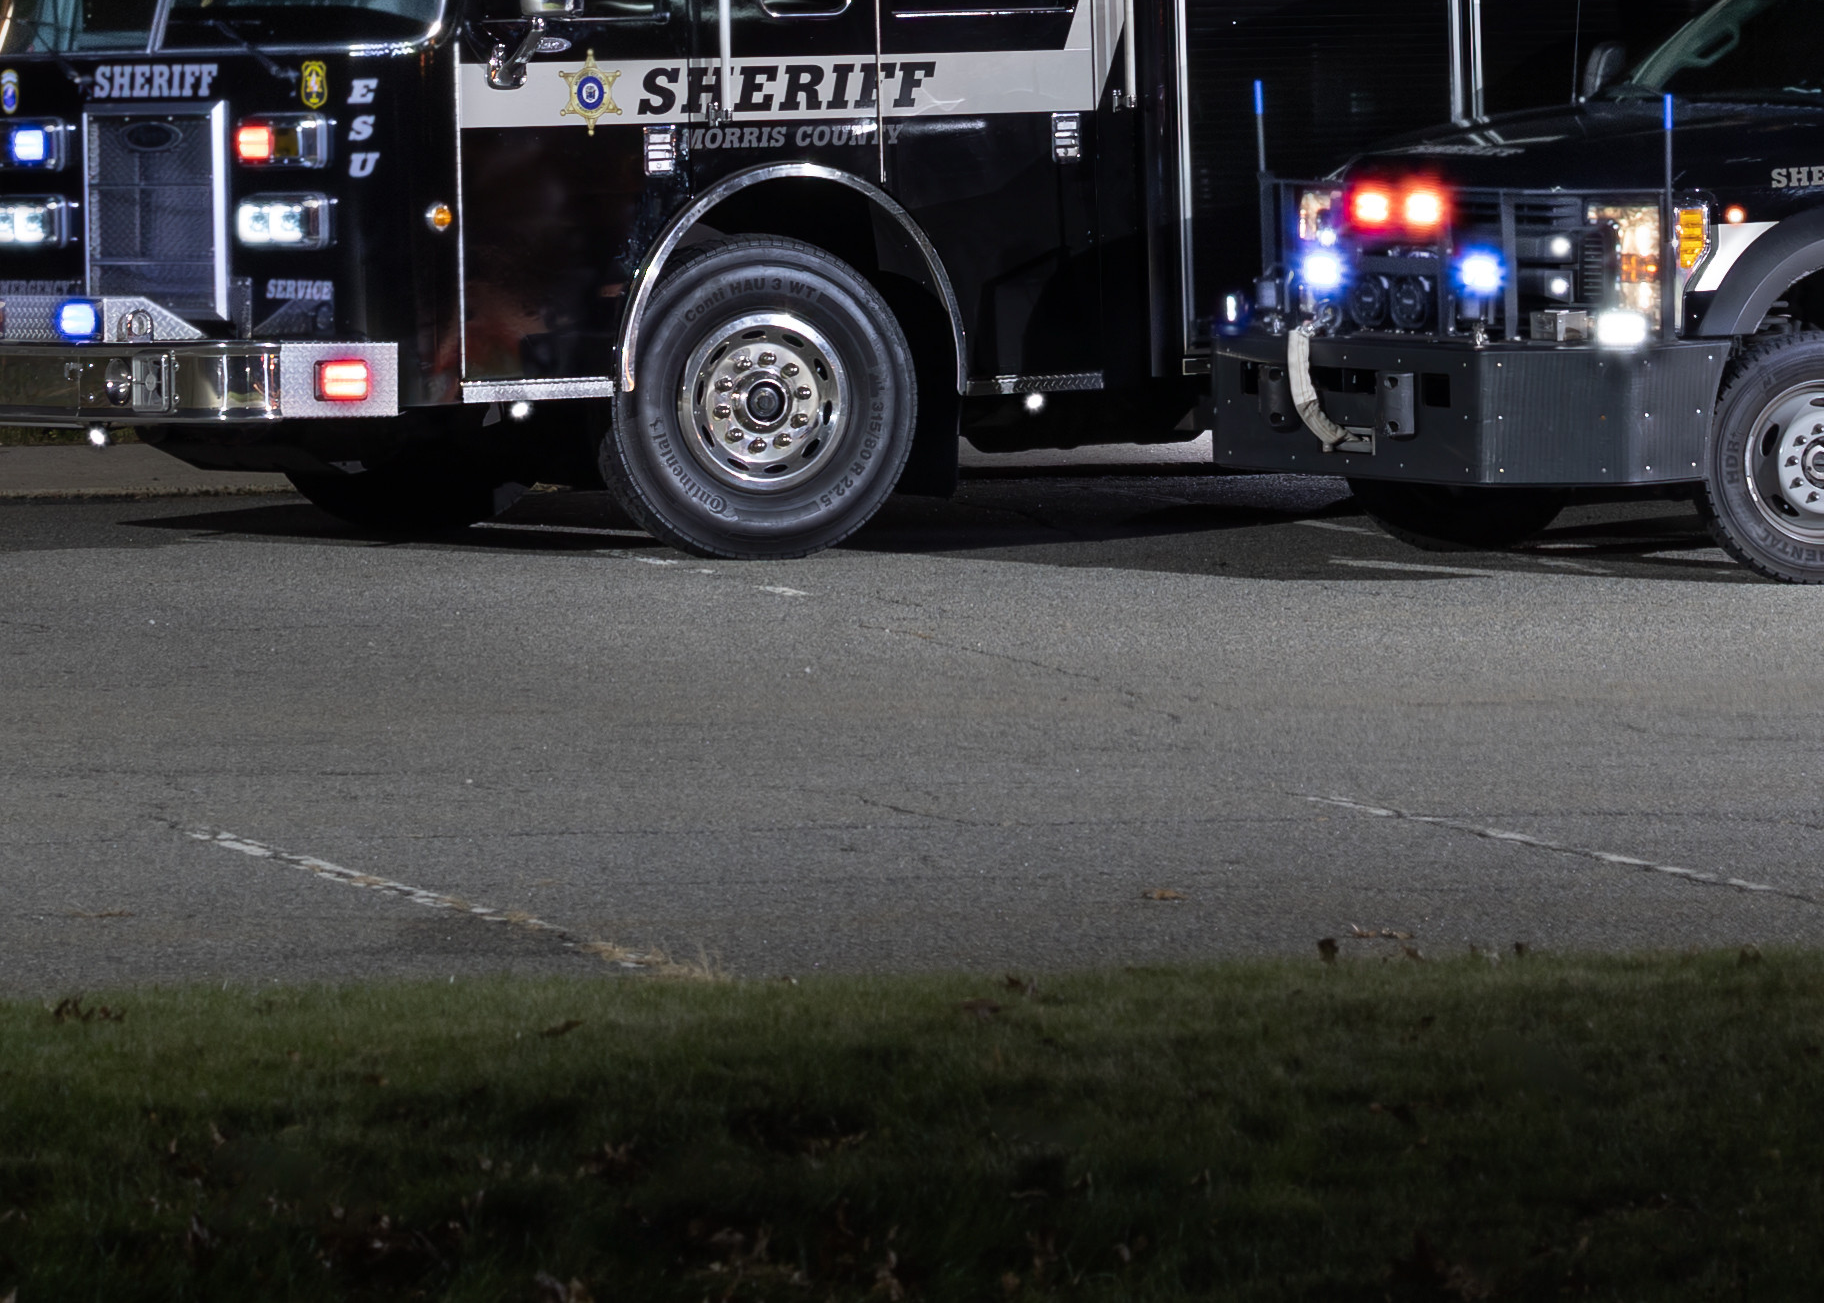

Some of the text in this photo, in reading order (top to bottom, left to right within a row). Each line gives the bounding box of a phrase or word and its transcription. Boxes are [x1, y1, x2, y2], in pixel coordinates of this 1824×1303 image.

[93, 62, 219, 99] SHERIFF
[637, 61, 937, 116] SHERIFF
[684, 126, 786, 150] MORRIS
[265, 278, 334, 301] SERVICE
[684, 277, 817, 322] Conti HAU 3 WT
